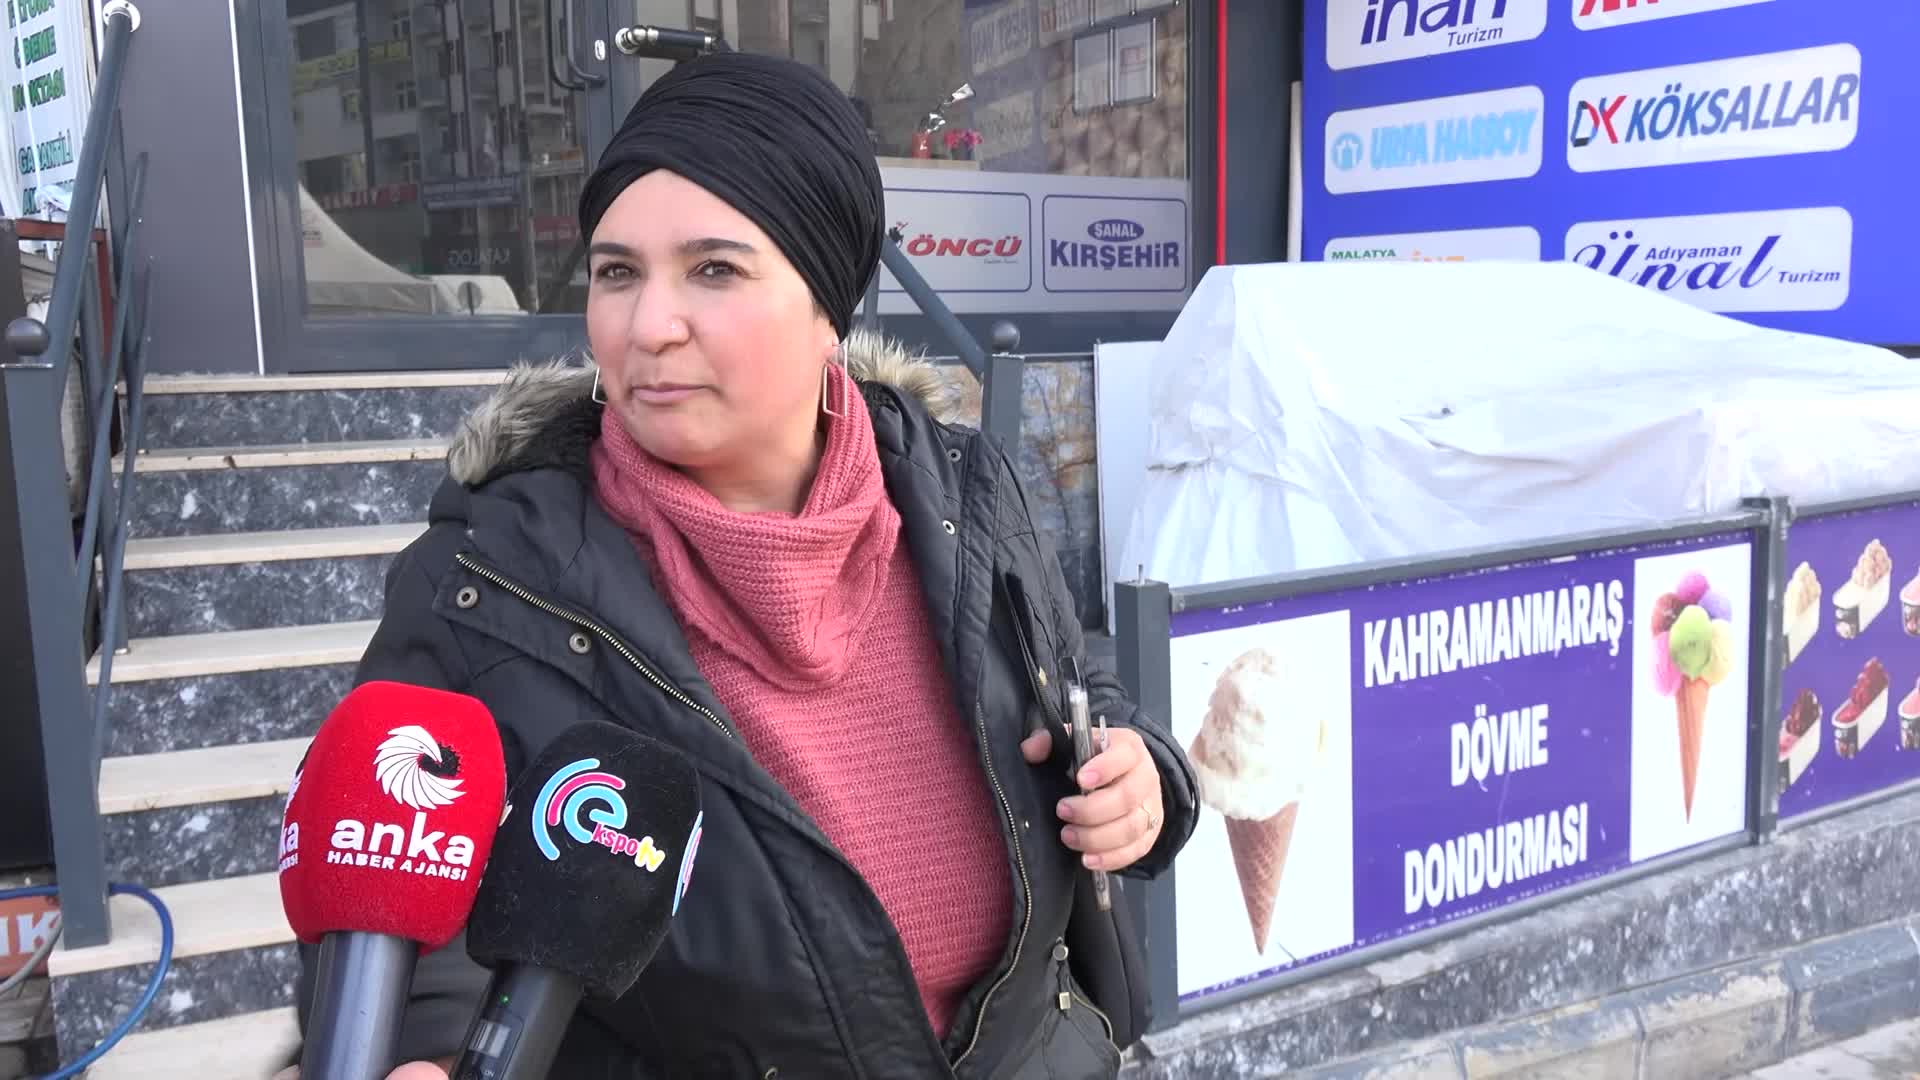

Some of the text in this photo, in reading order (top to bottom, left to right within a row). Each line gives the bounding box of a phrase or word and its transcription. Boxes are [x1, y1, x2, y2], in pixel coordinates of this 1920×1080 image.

[1447, 26, 1503, 47] Turizm
[1625, 73, 1859, 143] KÖKSALLAR
[1094, 223, 1137, 238] SANAL
[907, 235, 1022, 257] ÖNCÜ
[1331, 249, 1396, 259] MALATYA
[1645, 246, 1742, 262] Adıyaman
[1779, 271, 1840, 283] Turizm
[1363, 579, 1625, 688] KAHRAMANMARAŞ
[1451, 703, 1549, 787] DÖVME
[330, 811, 475, 867] anka
[327, 850, 468, 882] HABER AJANSI
[1404, 802, 1588, 915] DONDURMASI
